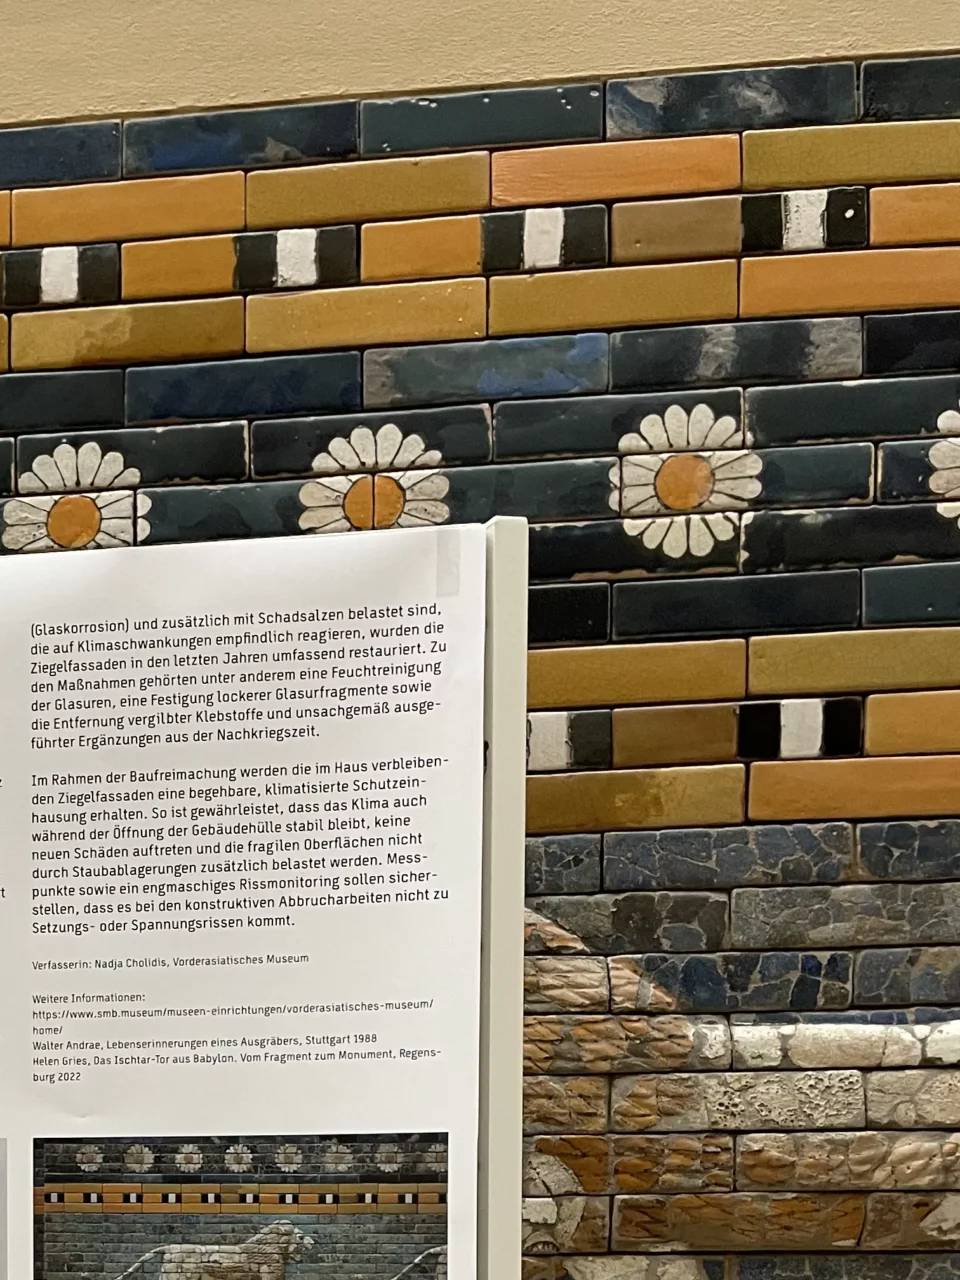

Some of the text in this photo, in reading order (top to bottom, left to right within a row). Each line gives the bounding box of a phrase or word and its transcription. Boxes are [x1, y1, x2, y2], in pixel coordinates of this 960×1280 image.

[30, 602, 442, 639] (Glaskorrosion) und zusätzlich mit Schadsalzen belastet sind,
[30, 724, 320, 751] führter Ergänzungen aus der Nachkriegszeit.
[31, 756, 449, 787] Im Rahmen der Baufreimachung werden die im Haus verbleiben-
[32, 914, 295, 937] Setzungs- oder Spannungsrissen kommt.
[31, 954, 310, 971] Verfasserin: Nadja Cholidis, Vorderasiatisches Museum
[31, 992, 146, 1004] Weitere Informationen:
[32, 1025, 64, 1036] home/
[32, 1033, 378, 1051] Walter Andrae, Lebenserinnerungen eines Ausgräbers, Stuttgart 1988
[32, 1048, 442, 1067] Helen Gries, Das Ischtar-Tor aus Babylon. Vom Fragment zum Monument, Regens-
[32, 1071, 82, 1084] burg 2022
